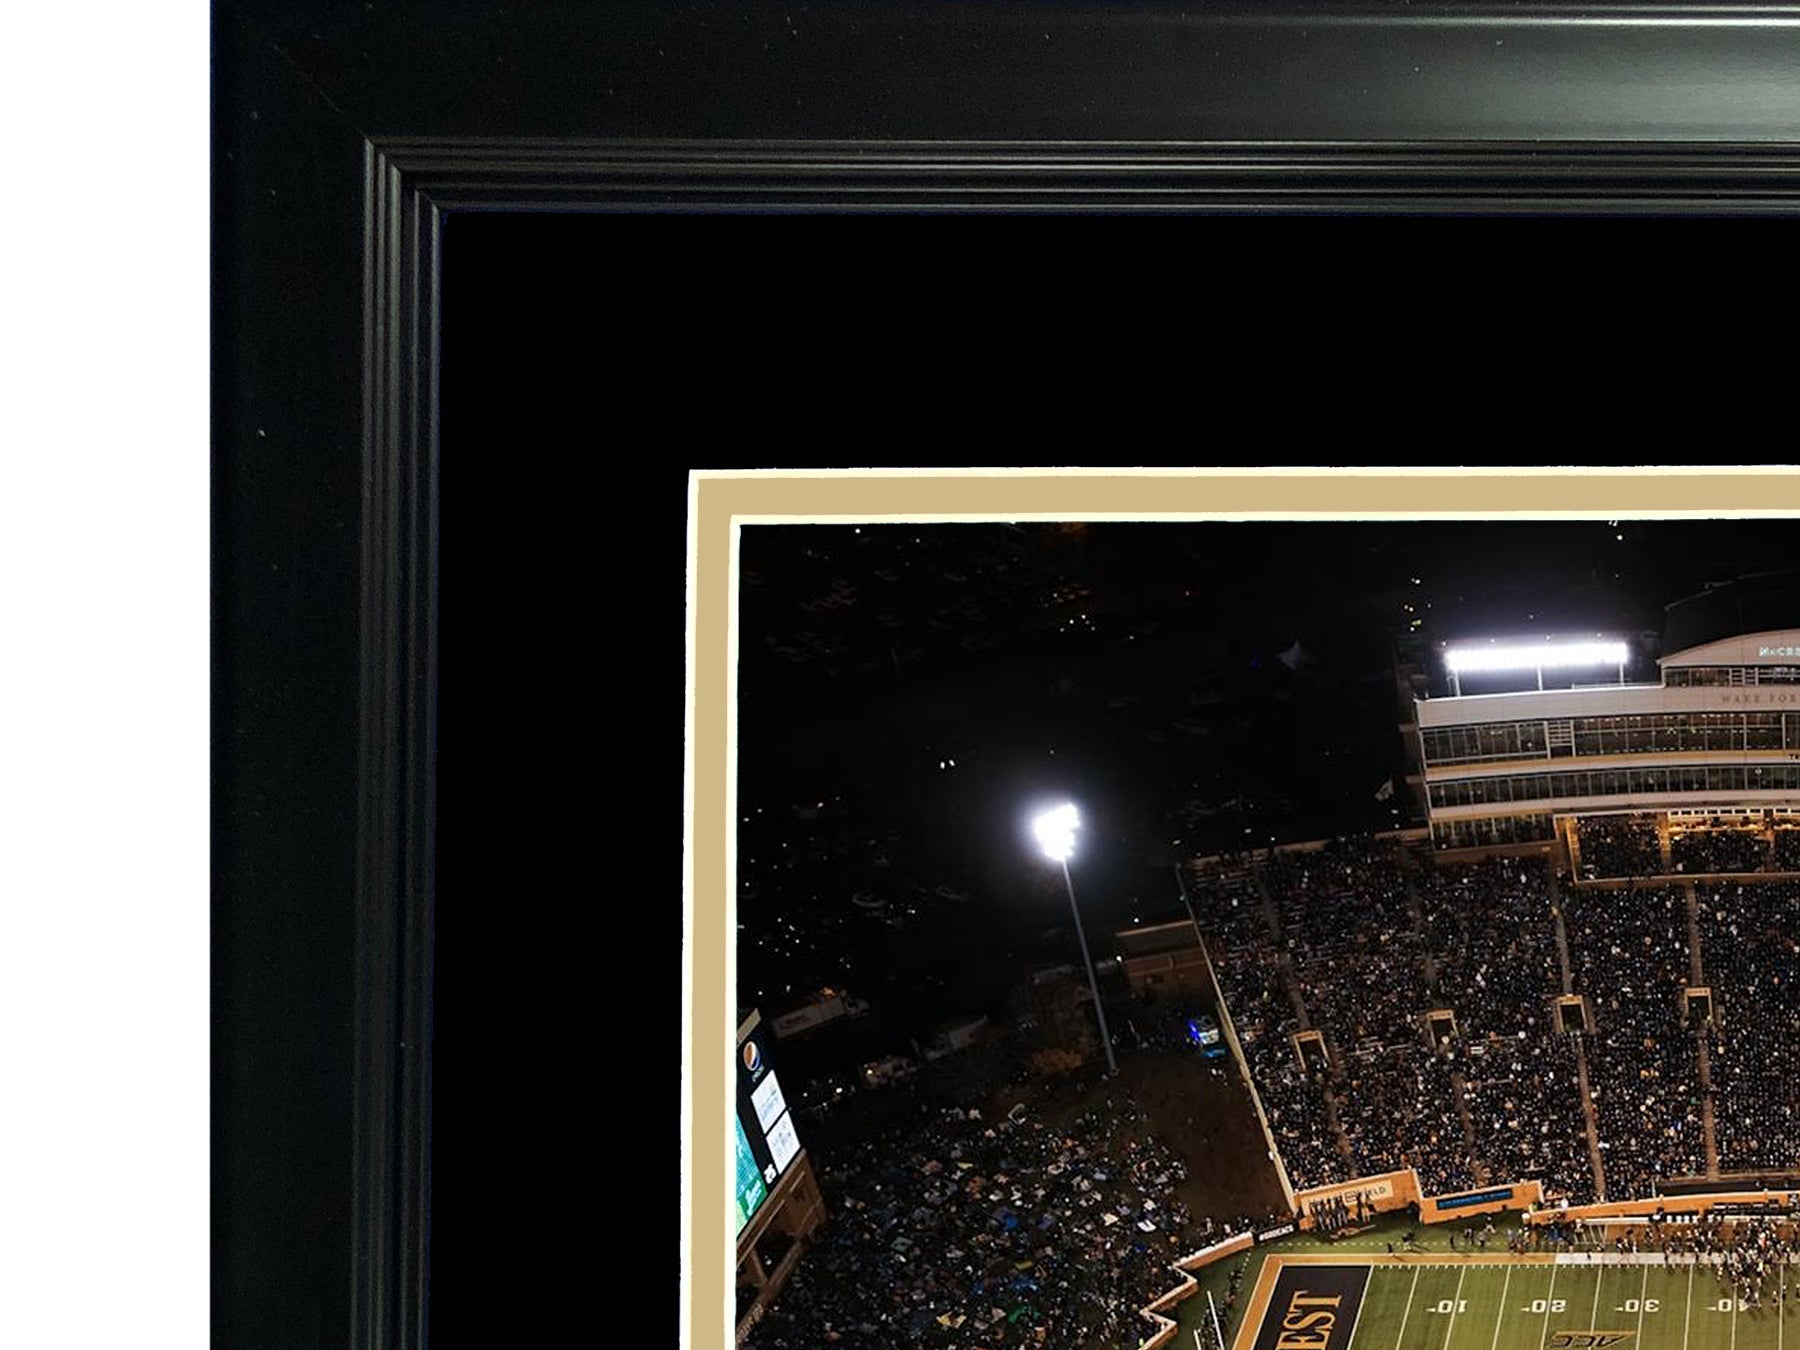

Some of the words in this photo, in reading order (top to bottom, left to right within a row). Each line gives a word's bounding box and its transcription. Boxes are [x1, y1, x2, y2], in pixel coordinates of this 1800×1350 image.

[1437, 1299, 1467, 1313] 10
[1532, 1299, 1568, 1312] 20
[1625, 1299, 1659, 1312] 30
